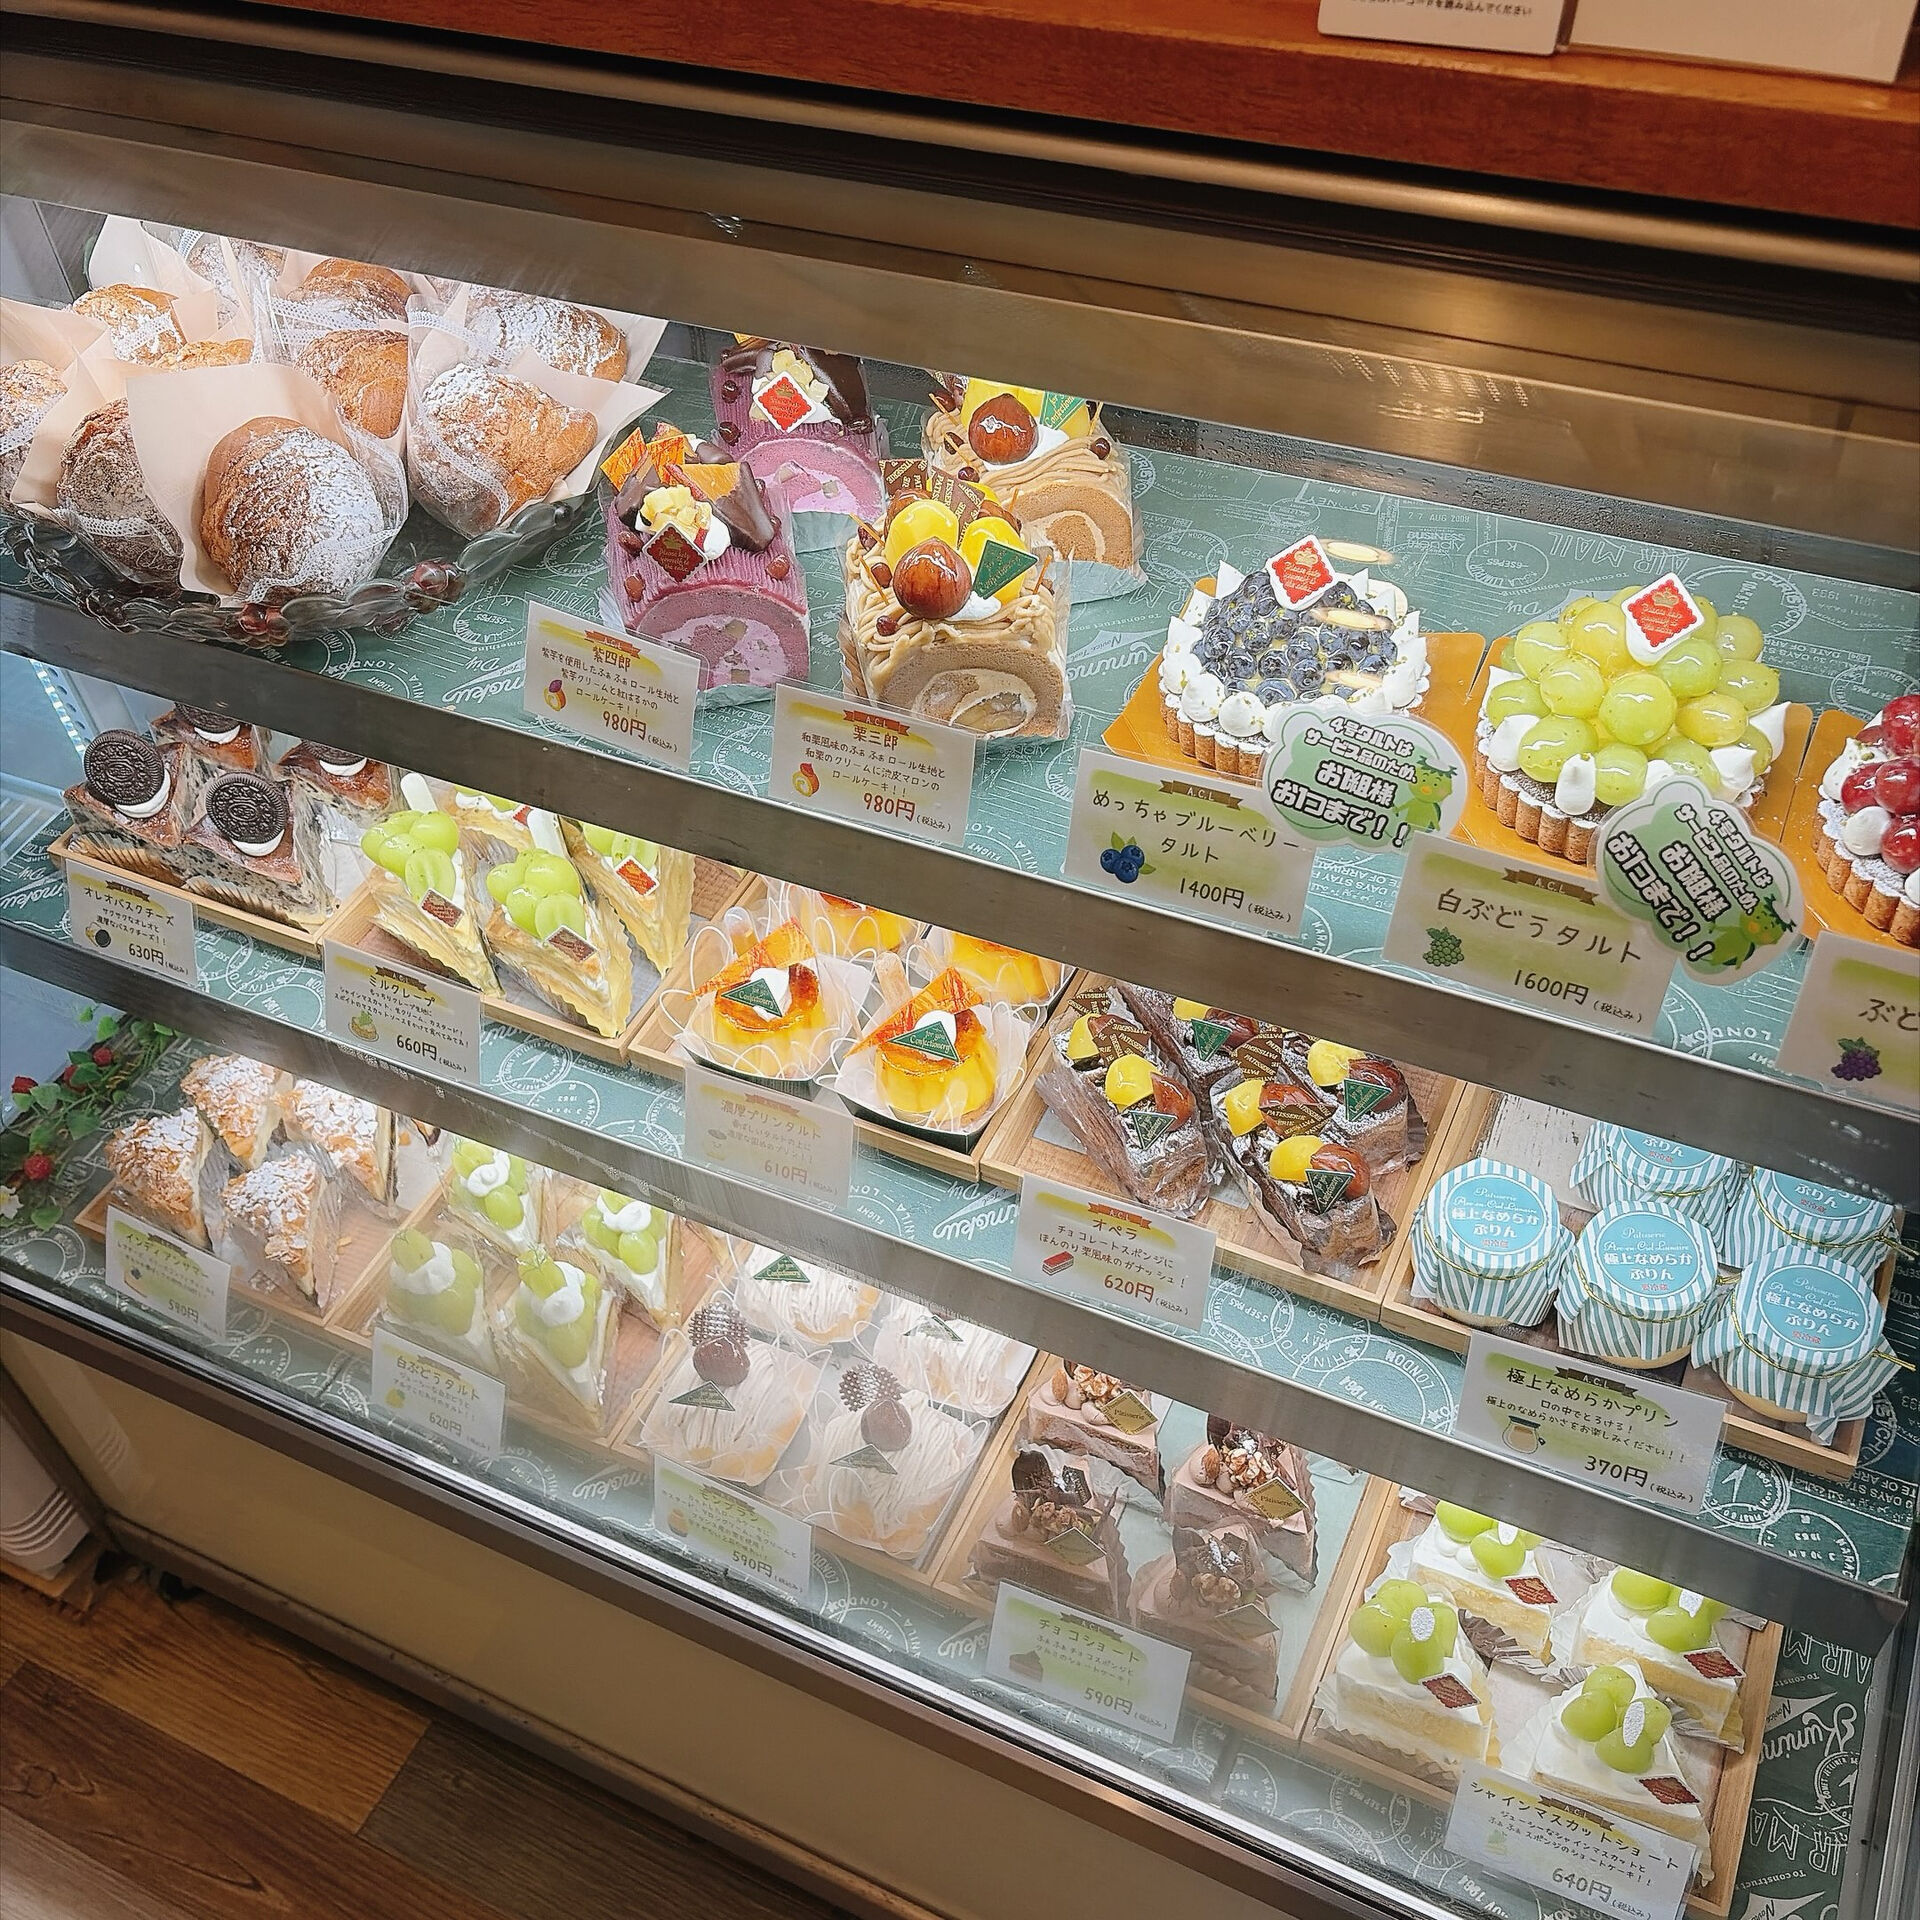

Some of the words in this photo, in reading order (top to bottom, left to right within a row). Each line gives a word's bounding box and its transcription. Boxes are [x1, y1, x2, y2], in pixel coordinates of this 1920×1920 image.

[1548, 532, 1626, 568] MAIL
[464, 656, 500, 672] Diy
[593, 646, 631, 672] 紫四郎
[367, 676, 394, 693] FLIGHT
[602, 711, 646, 741] 980円
[853, 725, 898, 750] 栗三郎
[1329, 715, 1414, 757] 4号タルトは
[863, 793, 915, 822] 980円
[1093, 789, 1300, 850] めっちゃブルーベリー
[1161, 837, 1221, 864] タルト
[84, 886, 175, 926] オレオバスクチーズ
[1179, 877, 1246, 910] 1400円
[1437, 888, 1642, 966] 白ぶどうタルト
[128, 944, 164, 966] 630円
[369, 975, 435, 1007] ミルクレープ
[1512, 968, 1591, 1006] 1600円
[397, 1034, 437, 1061] 660円
[910, 1035, 951, 1054] Confectionery
[721, 1100, 822, 1139] 濃厚プリンタルト
[764, 1160, 808, 1185] 610円
[857, 1205, 885, 1225] FLIGHT
[1093, 1219, 1138, 1240] オペラ
[1452, 1207, 1539, 1225] 極上なめらか
[1057, 1225, 1174, 1269] チョコレートスポンジに
[1603, 1252, 1692, 1265] 極上なめらか
[1105, 1275, 1155, 1303] 620円
[1765, 1291, 1859, 1330] 極上なめらか
[397, 1355, 480, 1400] 白ぶどうタルト
[1506, 1367, 1678, 1428] 極上なめらかプリン
[429, 1412, 461, 1436] 620円
[1540, 1400, 1633, 1434] 口の中でとろける！
[1584, 1456, 1648, 1487] 370円
[732, 1551, 773, 1577] 590円
[867, 1619, 894, 1640] FLIGHT
[1039, 1618, 1140, 1663] チョコショート
[1085, 1687, 1133, 1716] 590円
[1470, 1781, 1679, 1870] シャインマスカットショート
[1551, 1867, 1612, 1904] 640円
